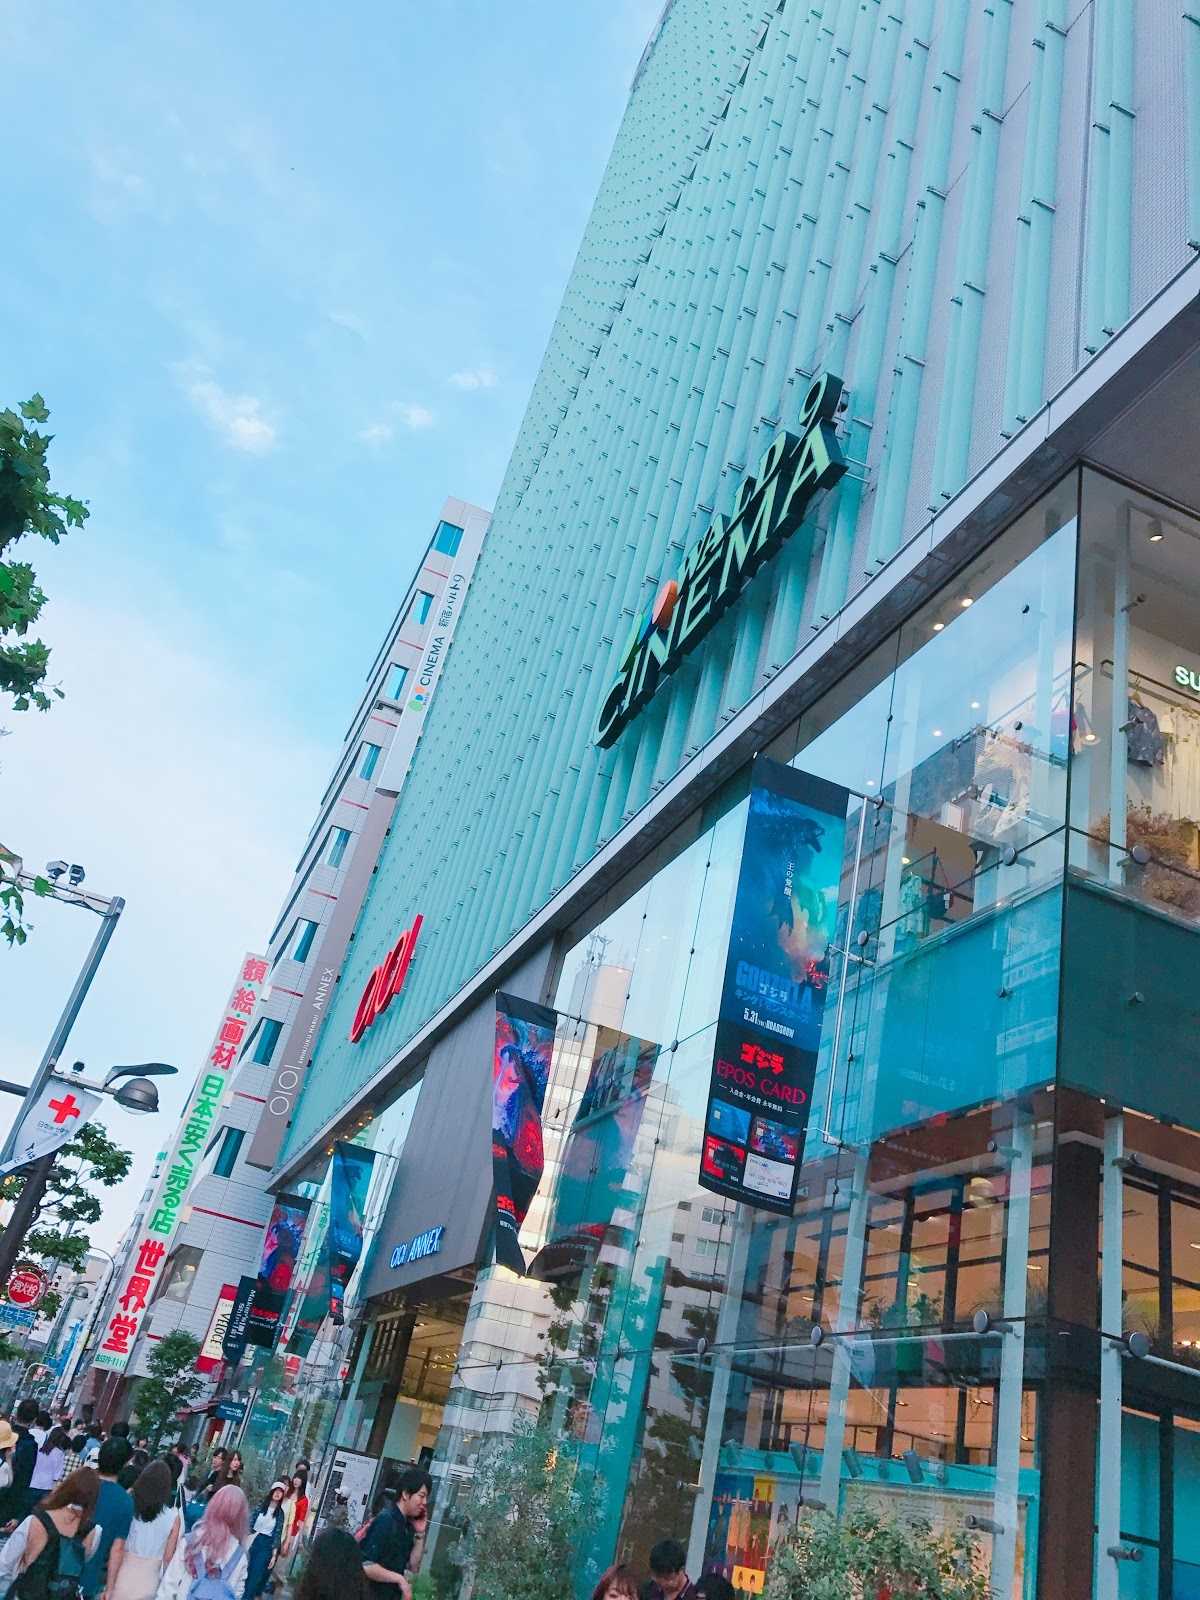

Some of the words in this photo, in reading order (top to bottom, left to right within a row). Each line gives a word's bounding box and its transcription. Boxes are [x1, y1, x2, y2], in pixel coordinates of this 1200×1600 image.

[788, 371, 836, 457] 9
[594, 418, 835, 746] CINEMA
[420, 636, 445, 686] CINEMA
[211, 957, 270, 1071] 額・絵・画材
[312, 967, 335, 1011] ANNEX
[743, 1007, 758, 1023] 5.31
[716, 1058, 756, 1089] EPOS
[759, 1078, 808, 1105] CARD
[148, 1073, 224, 1235] 日本一安く売る店
[407, 1226, 442, 1262] ANNEX
[102, 1239, 166, 1355] 世界堂
[210, 1313, 231, 1345] VELOCE
